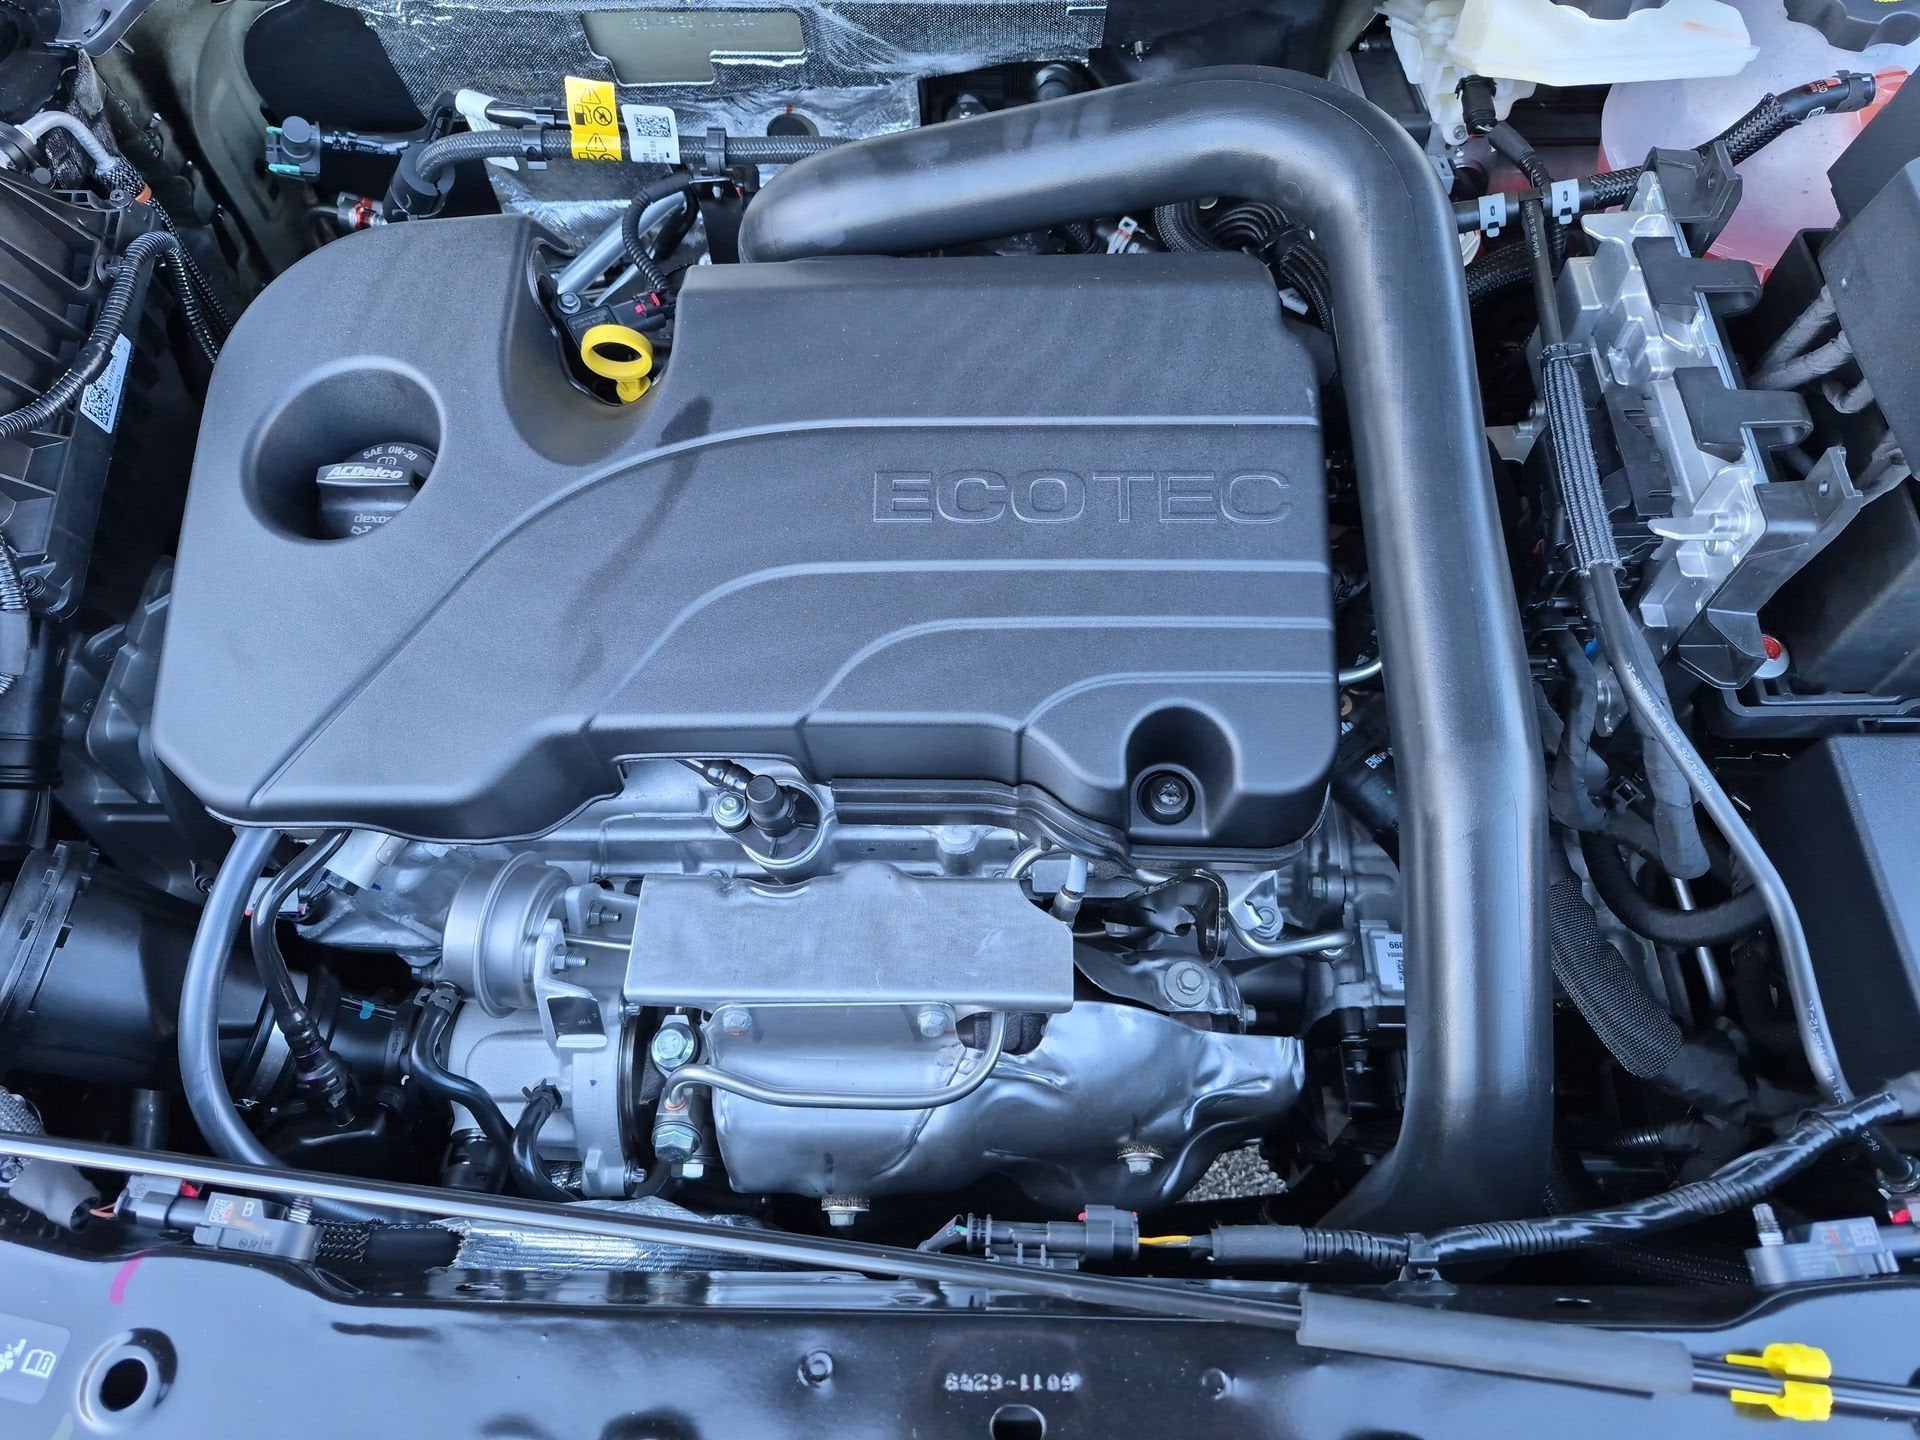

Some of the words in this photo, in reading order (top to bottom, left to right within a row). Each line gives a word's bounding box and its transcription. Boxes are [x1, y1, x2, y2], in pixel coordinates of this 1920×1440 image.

[362, 446, 383, 459] SAE
[388, 445, 418, 461] 0W-20
[326, 466, 404, 479] ACDelco
[873, 470, 1291, 524] ECOTEC
[241, 1200, 256, 1218] B
